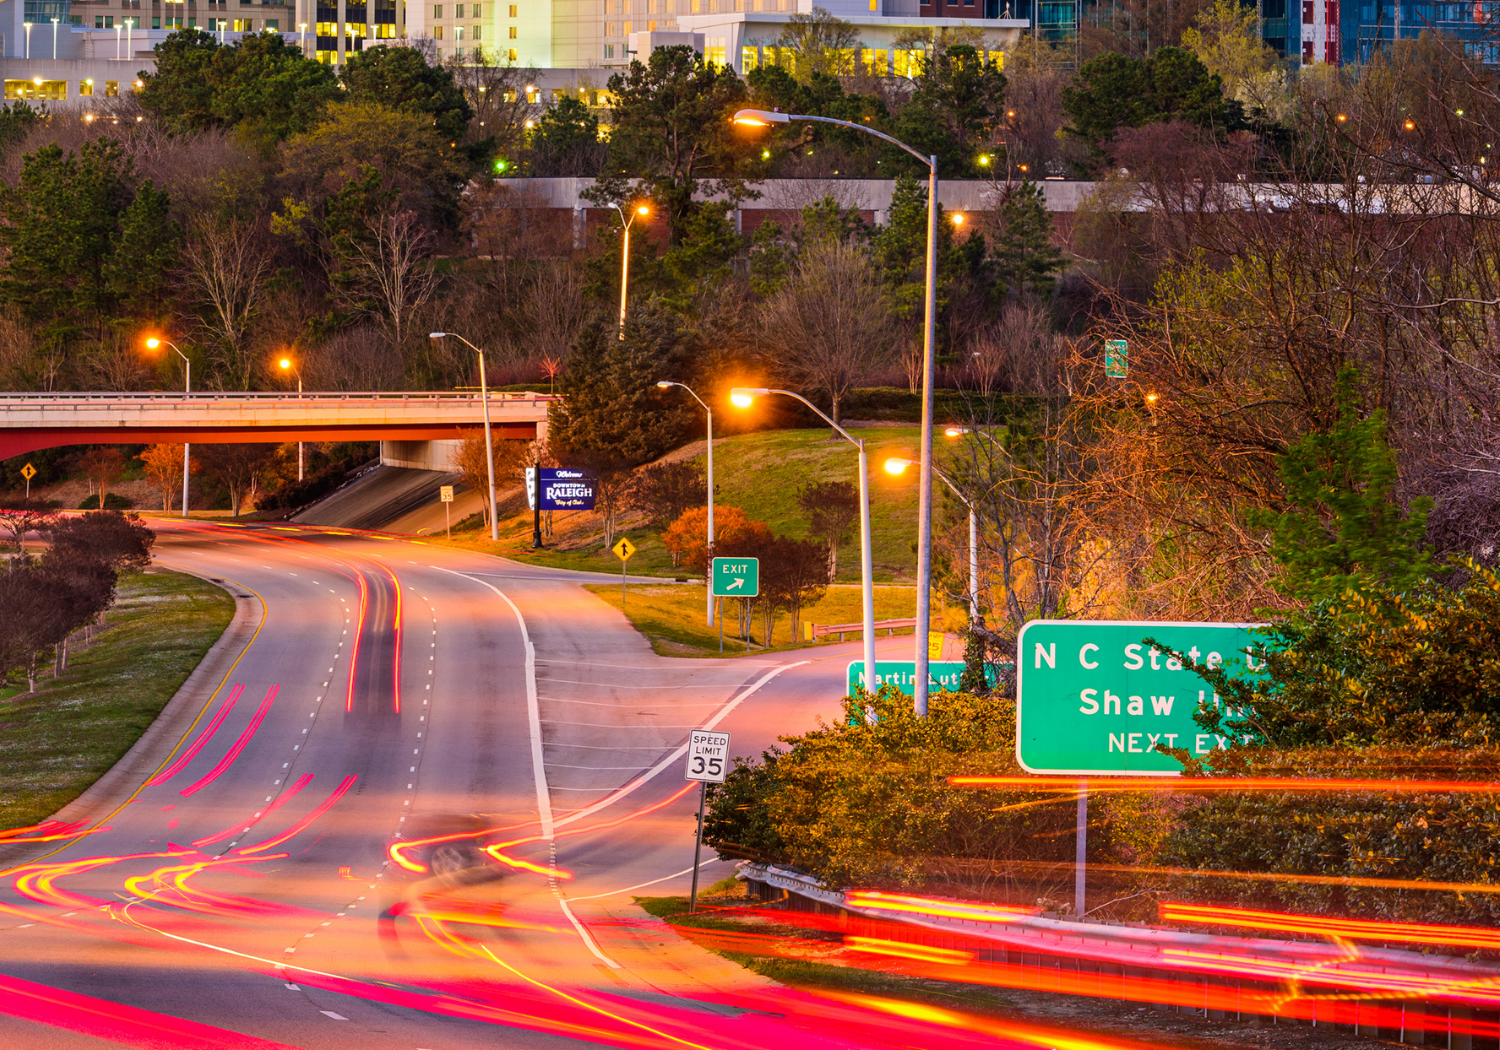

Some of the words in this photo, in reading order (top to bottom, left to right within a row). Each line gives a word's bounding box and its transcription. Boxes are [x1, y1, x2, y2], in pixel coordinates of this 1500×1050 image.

[546, 487, 593, 500] RALEIGH
[723, 564, 749, 574] EXIT
[1034, 642, 1056, 669] N
[1078, 643, 1100, 670] C
[1123, 643, 1223, 671] State
[1079, 688, 1175, 716] Shaw
[693, 735, 727, 746] SPEED
[1108, 733, 1179, 753] NEXT
[1195, 734, 1254, 754] EXT
[695, 746, 722, 755] LIMIT
[691, 756, 723, 776] 35
